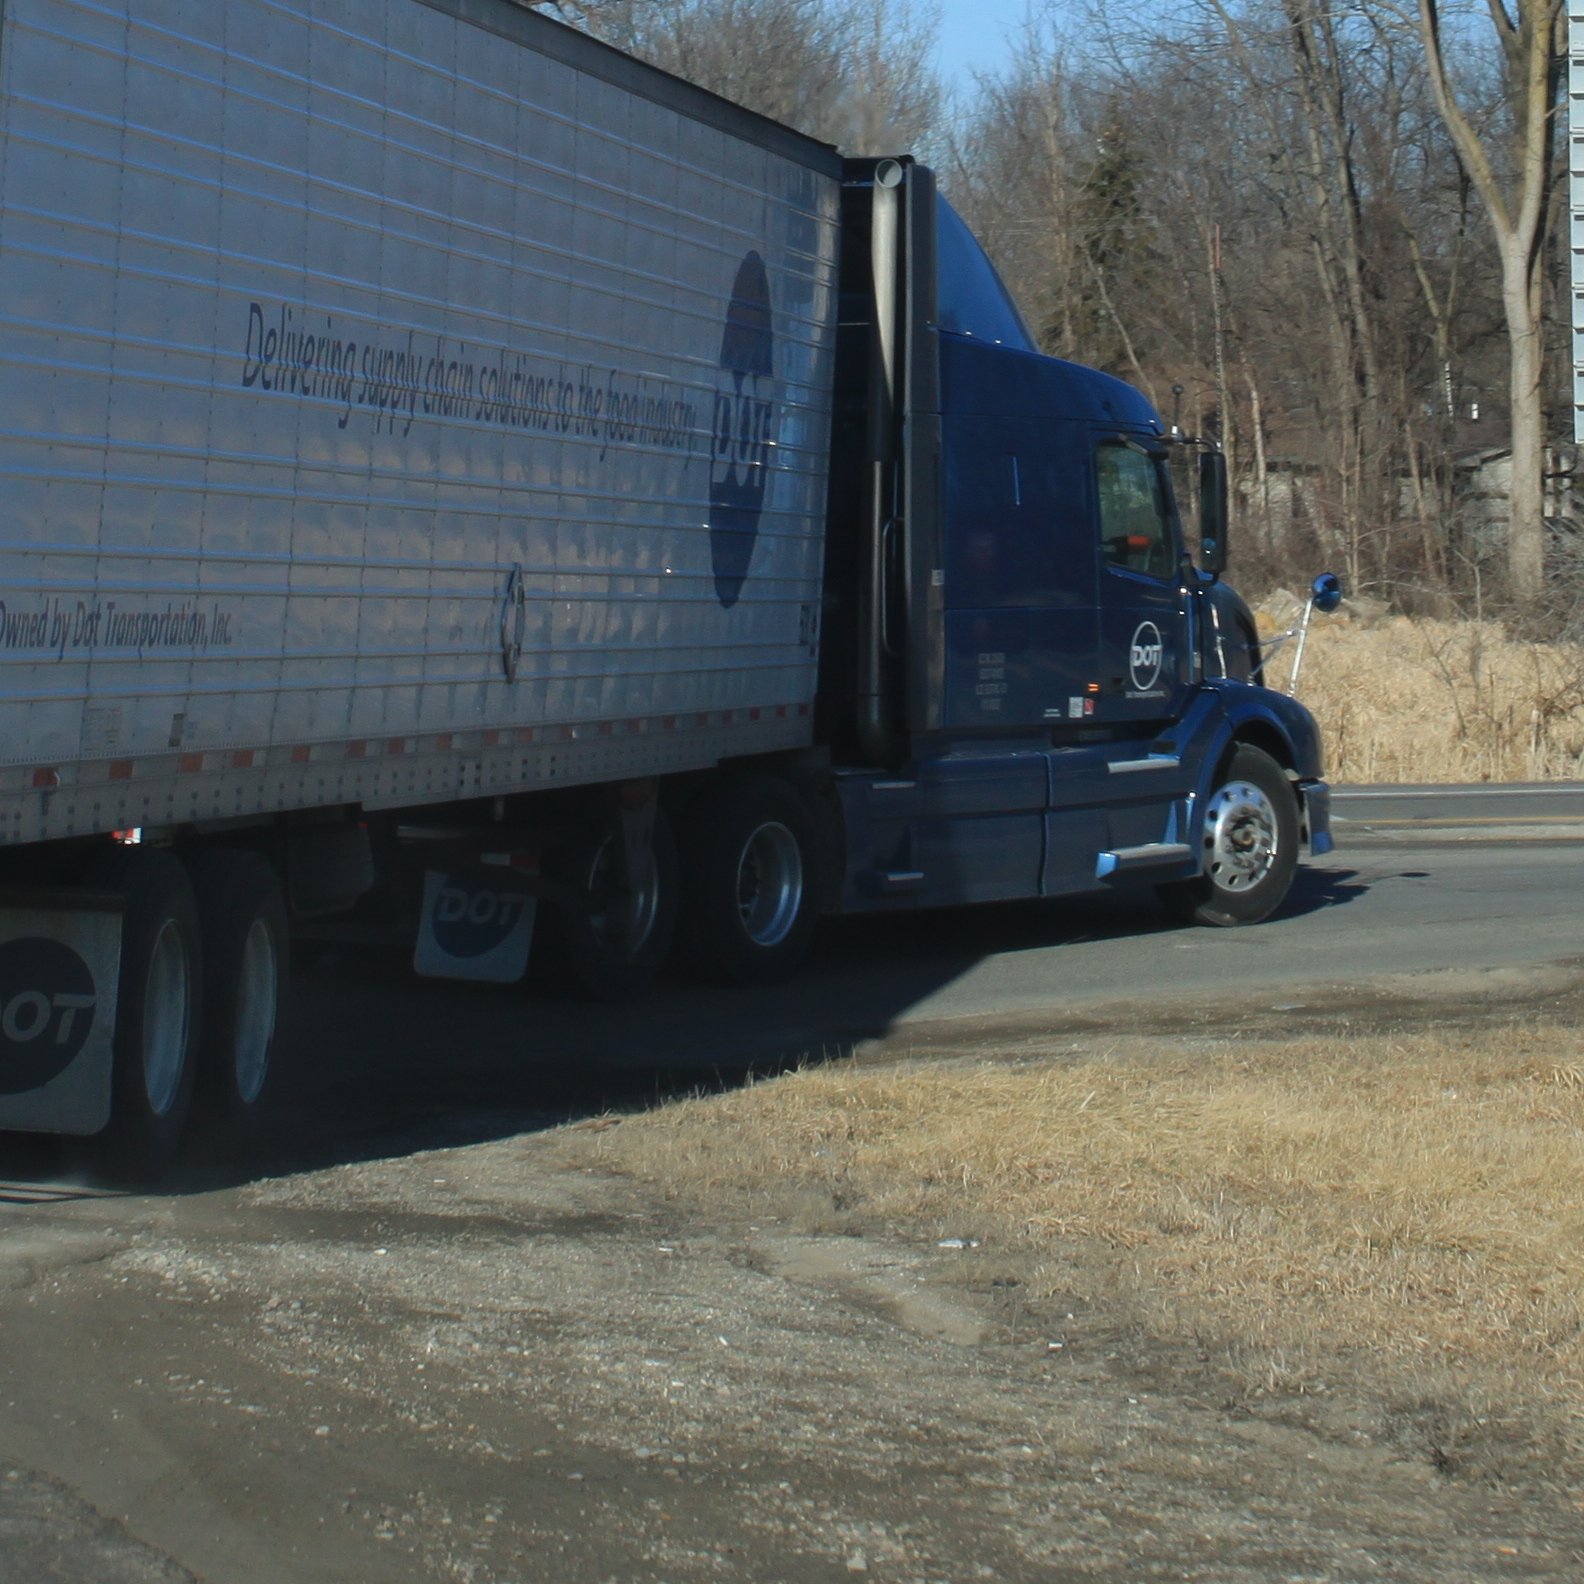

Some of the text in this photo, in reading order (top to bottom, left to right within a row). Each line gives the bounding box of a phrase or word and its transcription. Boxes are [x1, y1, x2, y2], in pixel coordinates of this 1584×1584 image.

[242, 302, 357, 429] Delivering
[358, 329, 423, 437] supply
[424, 335, 474, 418] chain
[476, 346, 554, 430] solutions
[554, 364, 574, 434] to
[575, 364, 603, 438] the
[712, 369, 772, 487] DOT
[50, 597, 72, 663] by
[72, 600, 102, 648] Dot
[104, 600, 208, 662] Transportation,
[210, 602, 233, 646] Inc.
[1131, 644, 1162, 667] DOT
